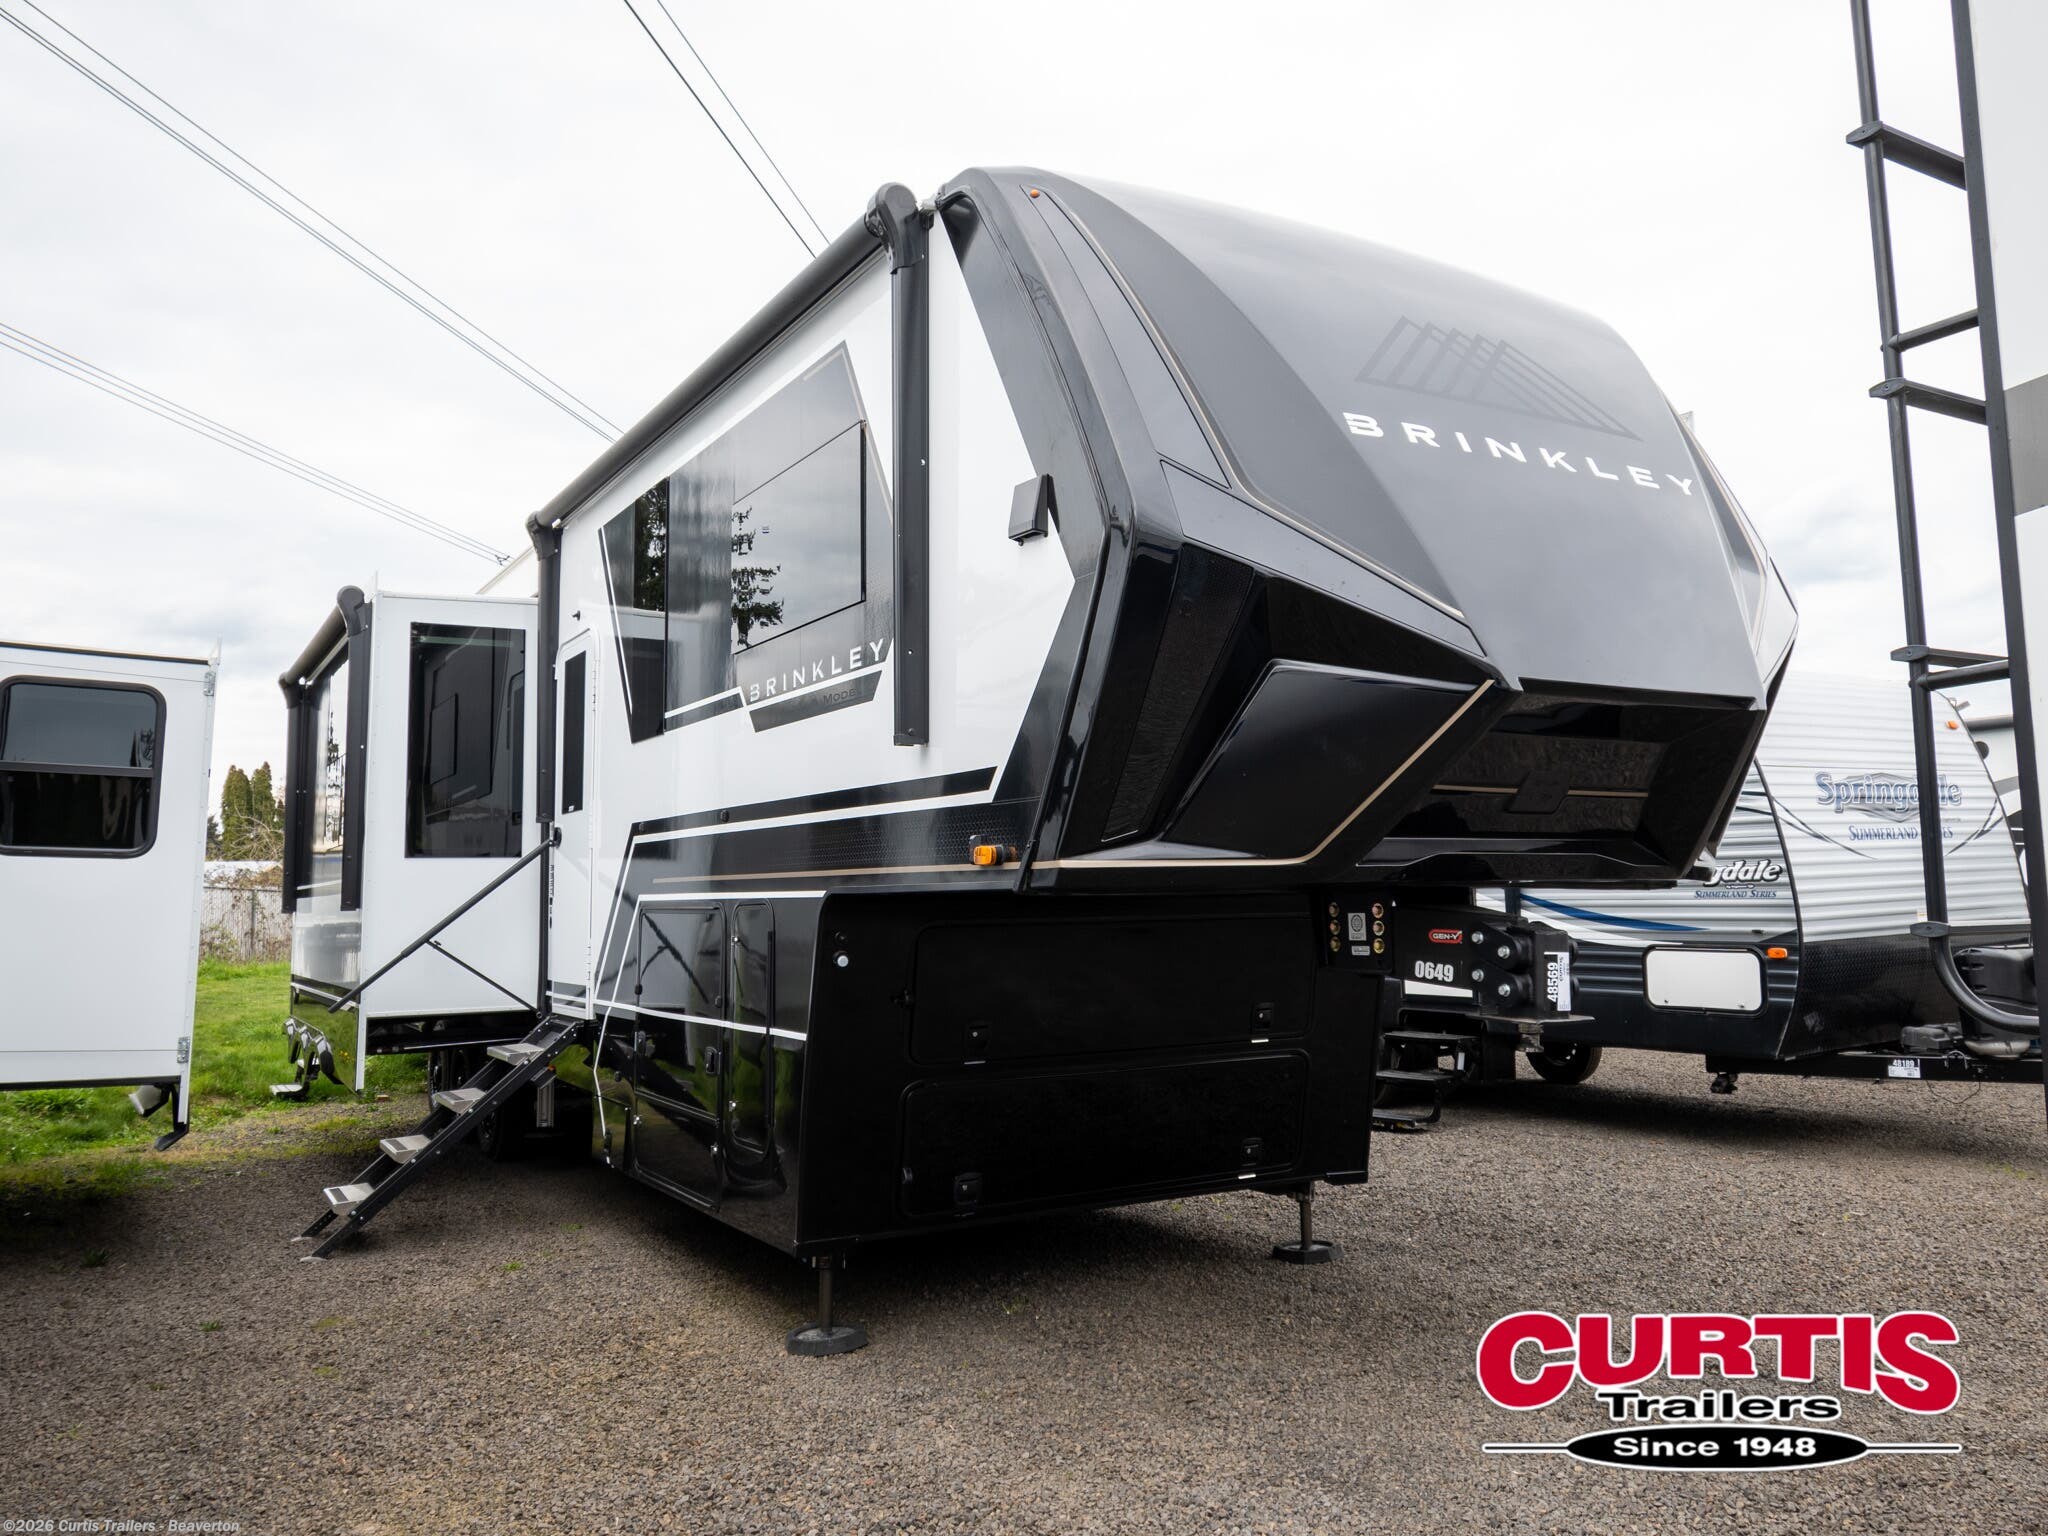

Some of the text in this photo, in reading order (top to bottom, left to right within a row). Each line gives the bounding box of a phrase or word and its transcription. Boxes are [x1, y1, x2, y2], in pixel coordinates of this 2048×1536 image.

[1343, 411, 1694, 496] BRINKLEY
[749, 639, 884, 702] BRINKLEY
[1815, 772, 1962, 813] Springle
[1703, 858, 1783, 887] gdale
[1432, 930, 1463, 940] GEN-Y
[1414, 960, 1454, 982] 0649
[1547, 962, 1558, 1003] 48569
